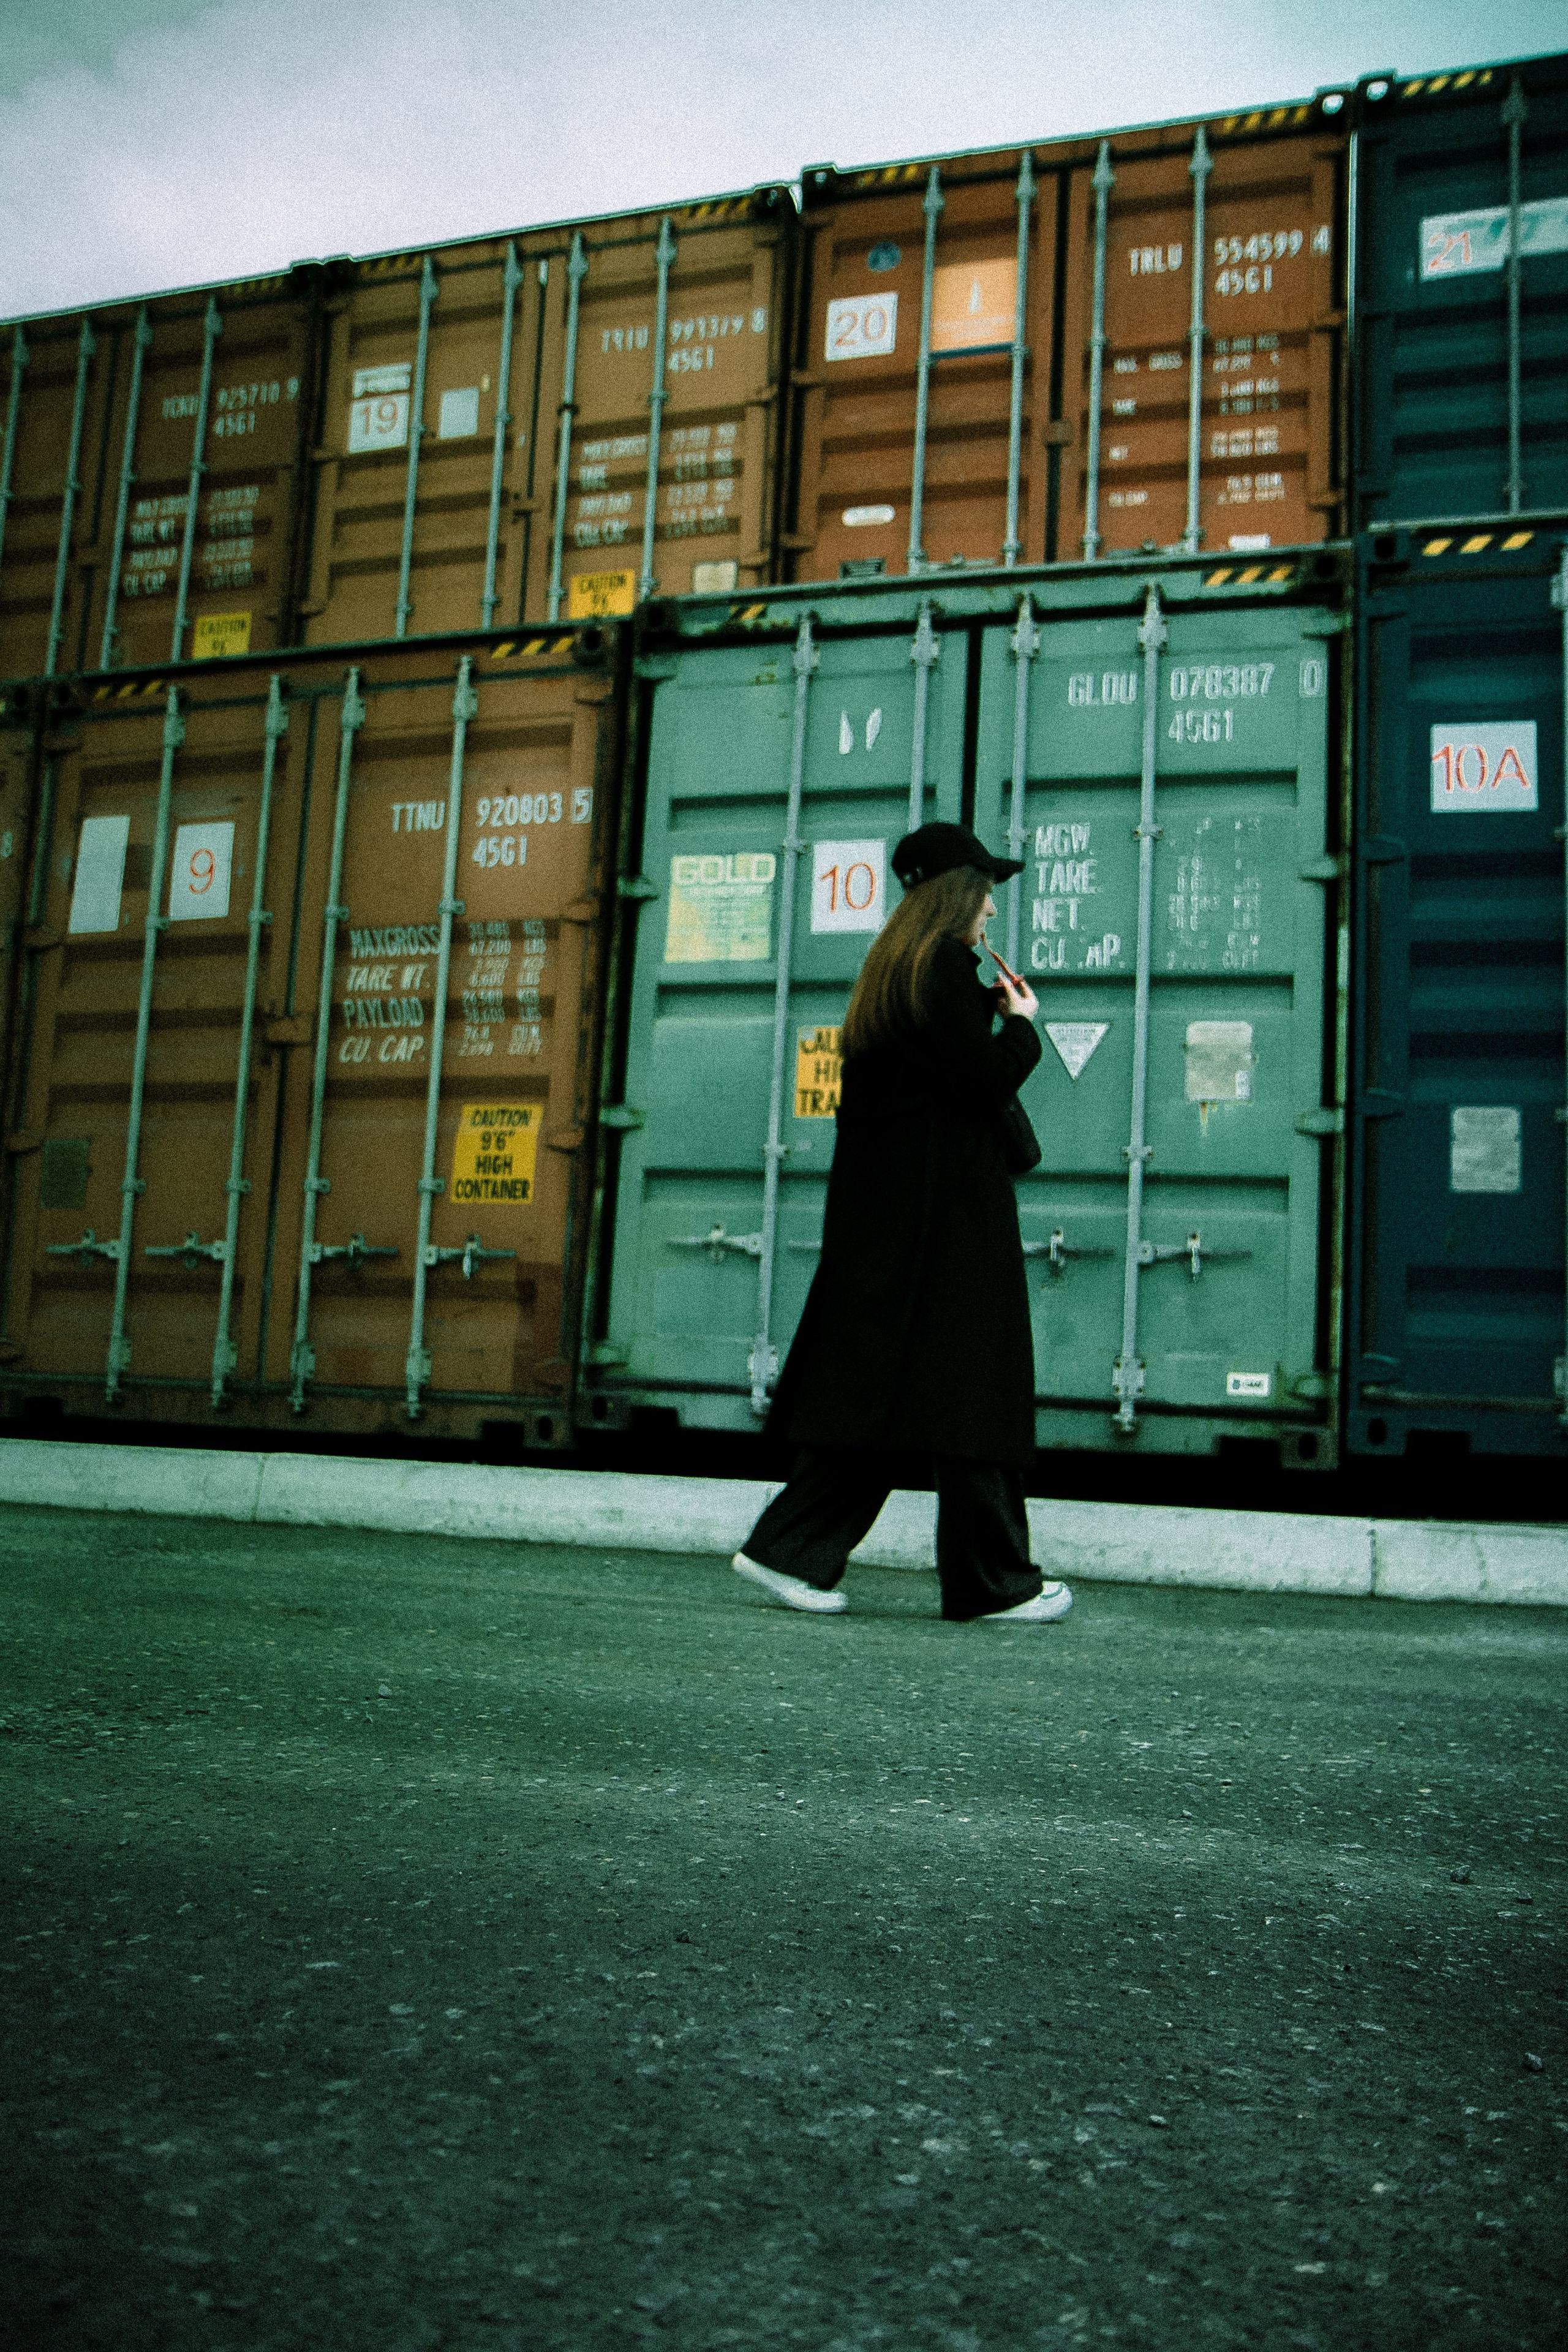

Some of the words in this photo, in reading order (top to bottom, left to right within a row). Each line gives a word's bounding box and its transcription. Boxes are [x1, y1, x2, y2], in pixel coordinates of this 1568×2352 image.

[1130, 244, 1183, 276] TRLU
[1213, 229, 1303, 266] 554599
[1311, 225, 1330, 257] 4
[1428, 230, 1472, 271] 21
[1213, 264, 1273, 296] 45G1
[834, 306, 888, 347] 20
[359, 396, 399, 436] 19
[1169, 662, 1275, 703] 078387
[1300, 661, 1324, 698] 0
[1167, 708, 1235, 743] 45G1
[1431, 743, 1531, 794] 10A
[391, 801, 445, 834] TTNU
[476, 792, 564, 827] 920803
[572, 787, 594, 824] 5
[472, 835, 528, 869] 45G1
[188, 848, 216, 894] 9
[674, 854, 776, 886] GOLD
[820, 861, 876, 914] 10
[347, 964, 399, 992] TARE
[342, 997, 424, 1030] PAYLOAD
[378, 1035, 426, 1064] CAP.
[815, 1058, 839, 1084] HI
[470, 1109, 532, 1127] CAUTION
[797, 1088, 840, 1115] TRA
[475, 1154, 513, 1175] HIGH
[454, 1178, 530, 1199] CONTAINER
